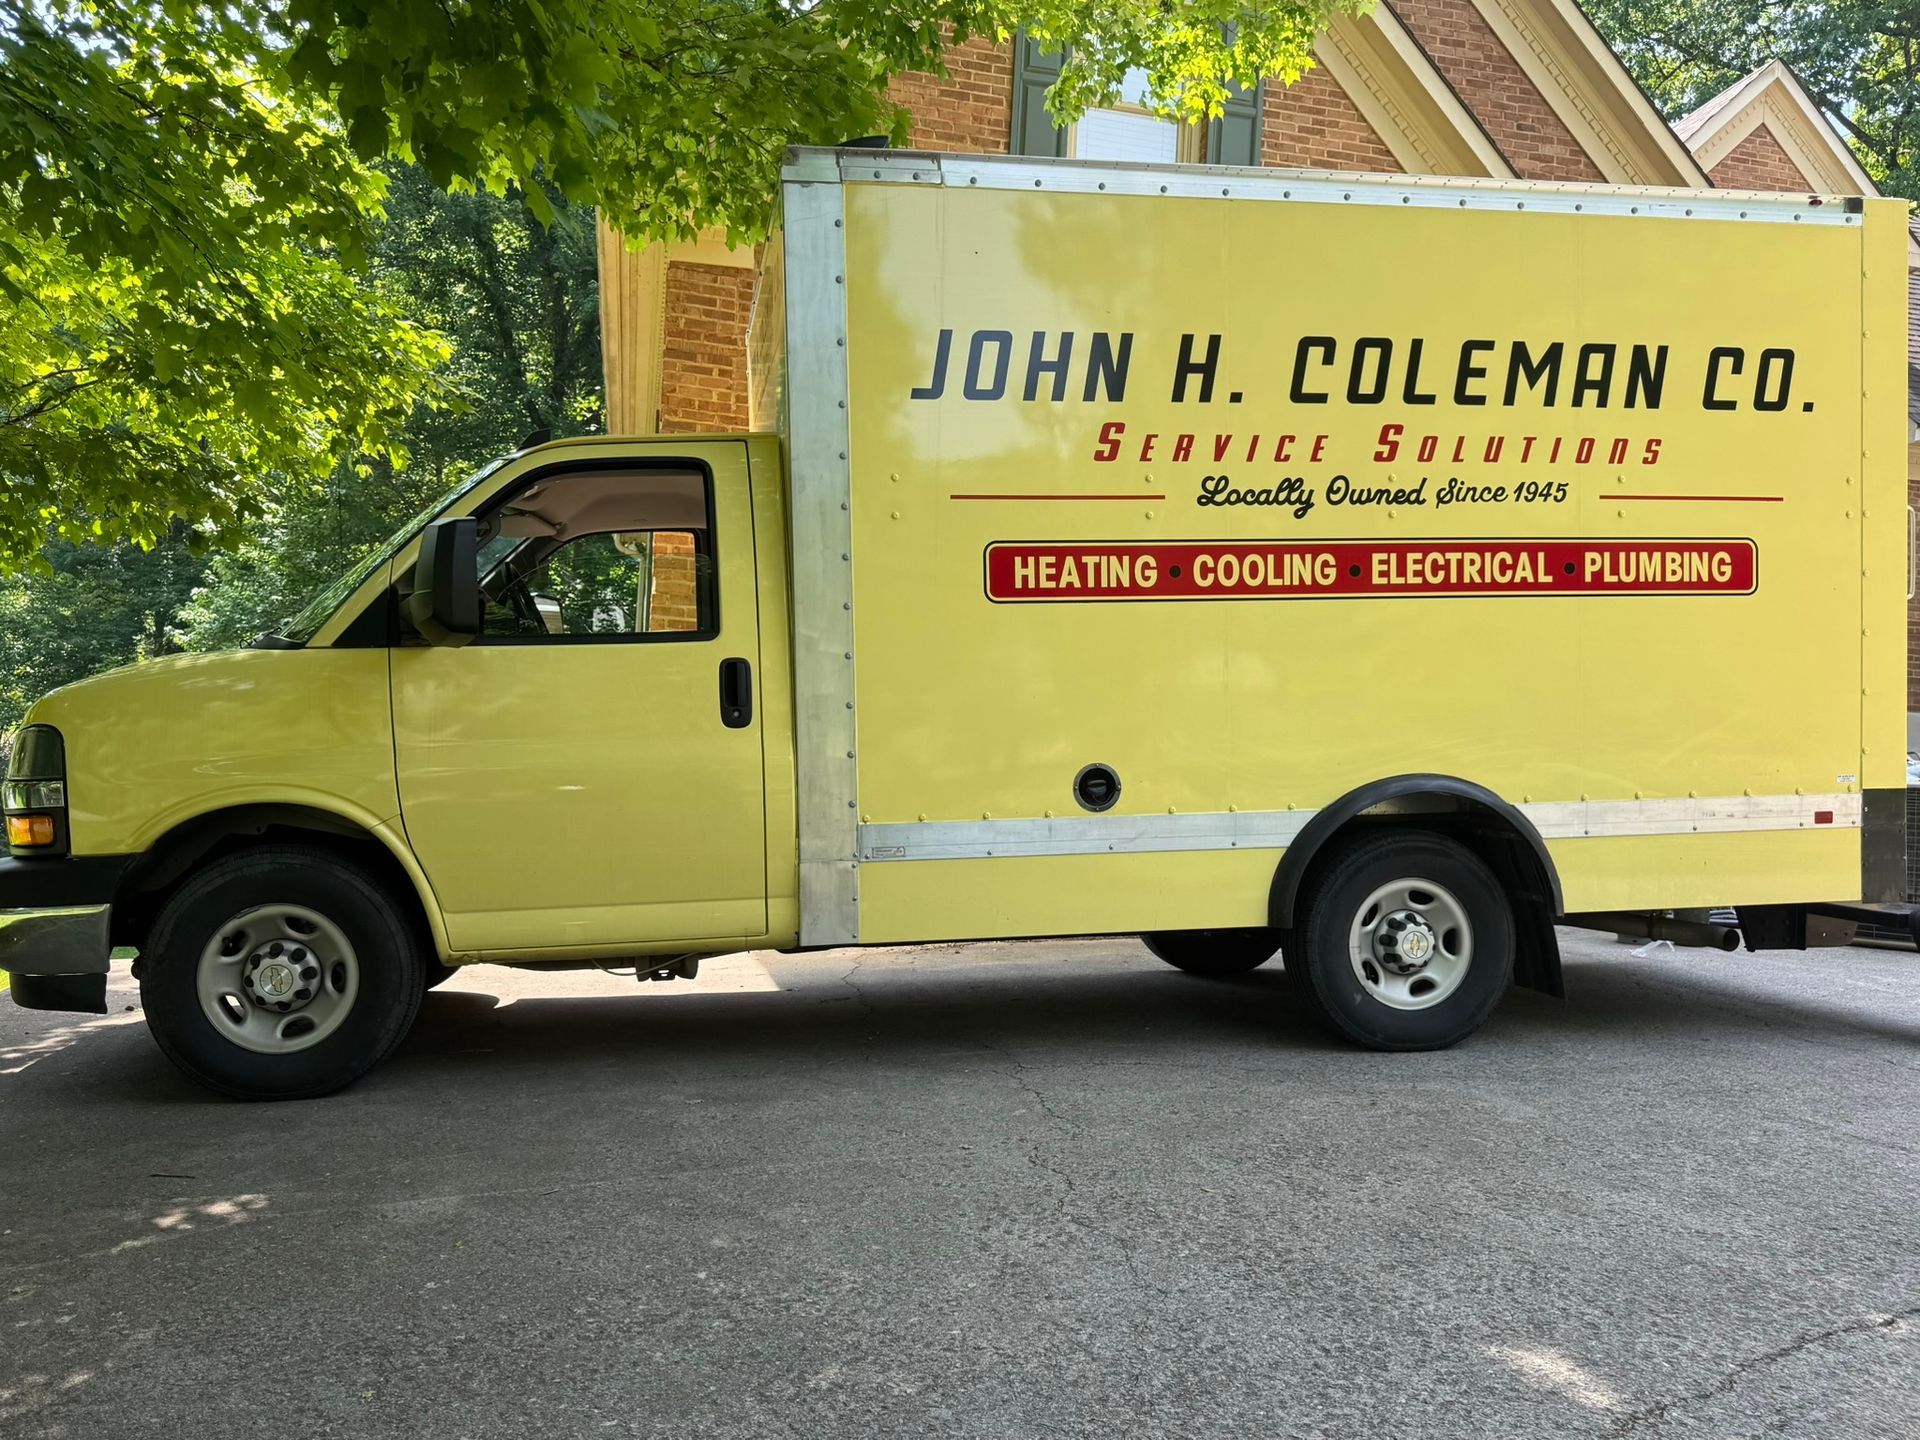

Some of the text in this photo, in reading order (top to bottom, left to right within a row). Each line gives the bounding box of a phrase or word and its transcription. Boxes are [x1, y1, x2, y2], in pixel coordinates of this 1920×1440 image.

[910, 329, 1814, 413] JOHN H. COLEMAN CO.
[1196, 475, 1568, 519] Locally Owned Since 1945
[1013, 551, 1732, 590] HEATING COOLING ELECTRICAL PLUMBING
